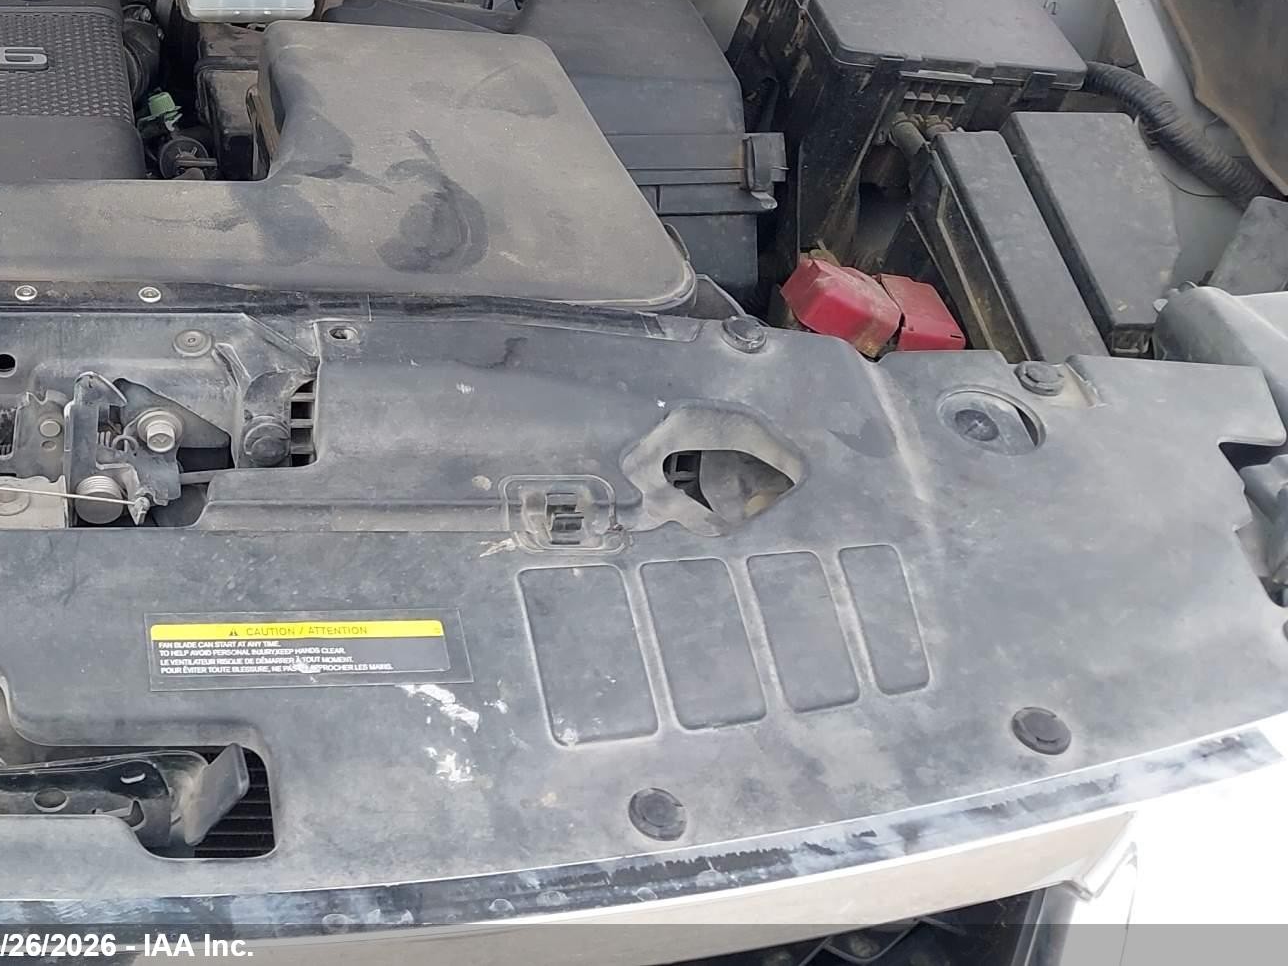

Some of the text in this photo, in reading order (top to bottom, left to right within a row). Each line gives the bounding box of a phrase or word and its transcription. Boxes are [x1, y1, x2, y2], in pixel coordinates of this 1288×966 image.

[246, 626, 368, 636] CAUTION / ATTENTION
[158, 641, 172, 649] FAN
[255, 656, 294, 664] DÉMARRER
[182, 665, 208, 674] ÉVITER
[232, 665, 271, 673] BLESSURE,
